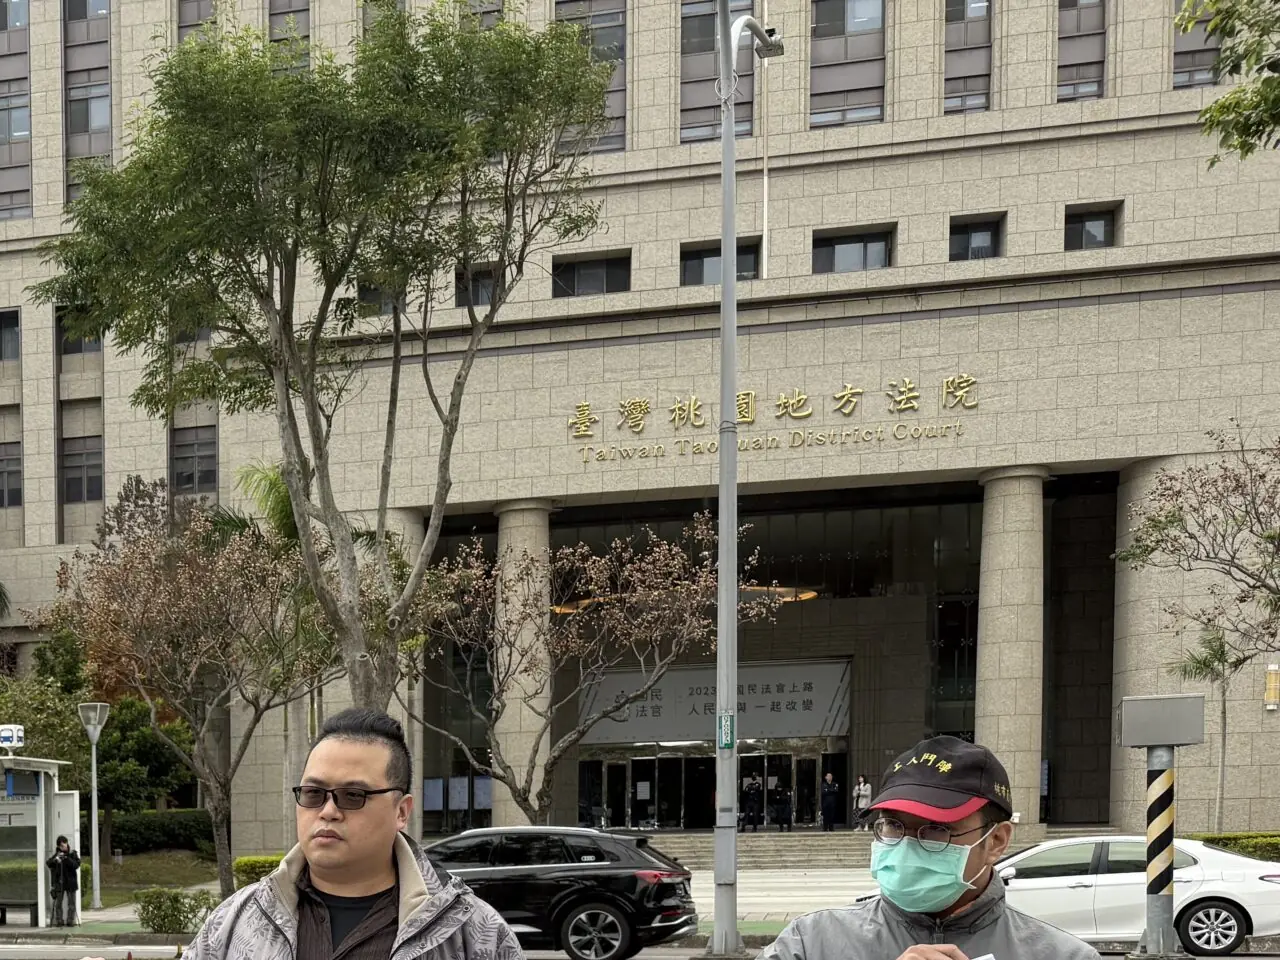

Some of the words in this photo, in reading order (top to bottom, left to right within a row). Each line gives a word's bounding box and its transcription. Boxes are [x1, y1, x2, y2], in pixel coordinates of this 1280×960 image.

[568, 374, 980, 438] 臺灣桃園地方法院
[579, 442, 666, 463] Taiwan
[674, 434, 780, 457] Taouan
[789, 423, 885, 447] District
[892, 416, 966, 441] Court
